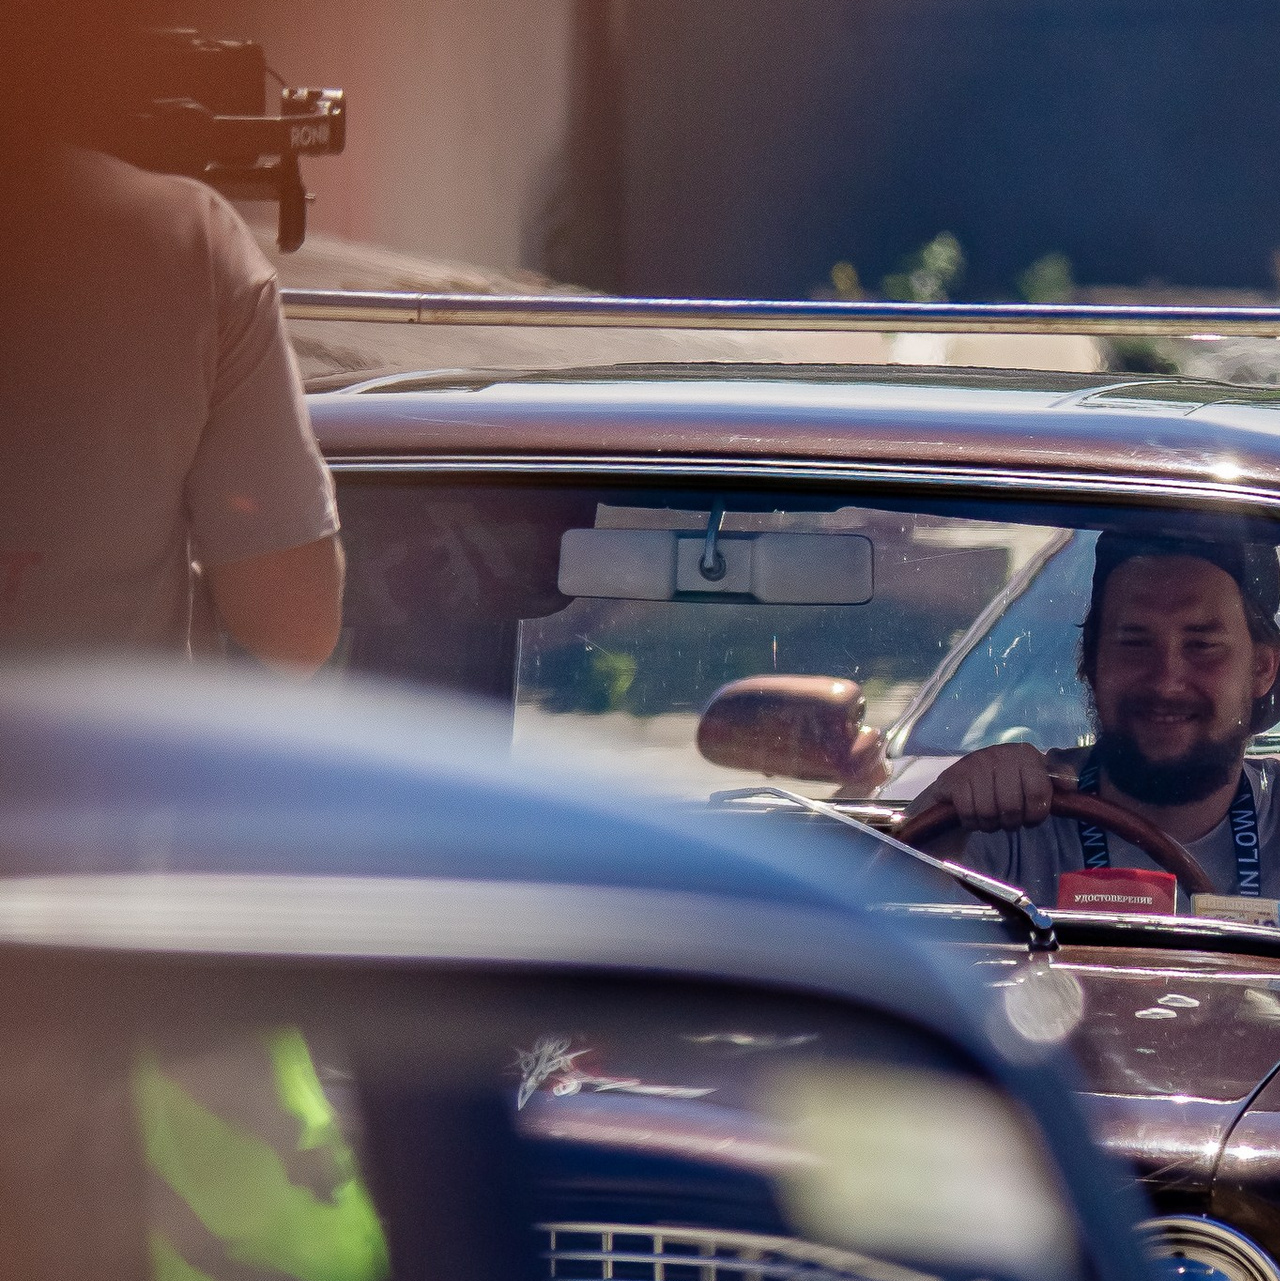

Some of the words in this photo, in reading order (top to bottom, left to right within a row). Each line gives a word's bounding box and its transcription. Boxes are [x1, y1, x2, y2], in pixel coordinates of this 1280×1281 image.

[1231, 810, 1259, 863] LOW
[1240, 870, 1259, 895] IN
[1073, 893, 1153, 906] УДОСТОВЕРЕНИЕ
